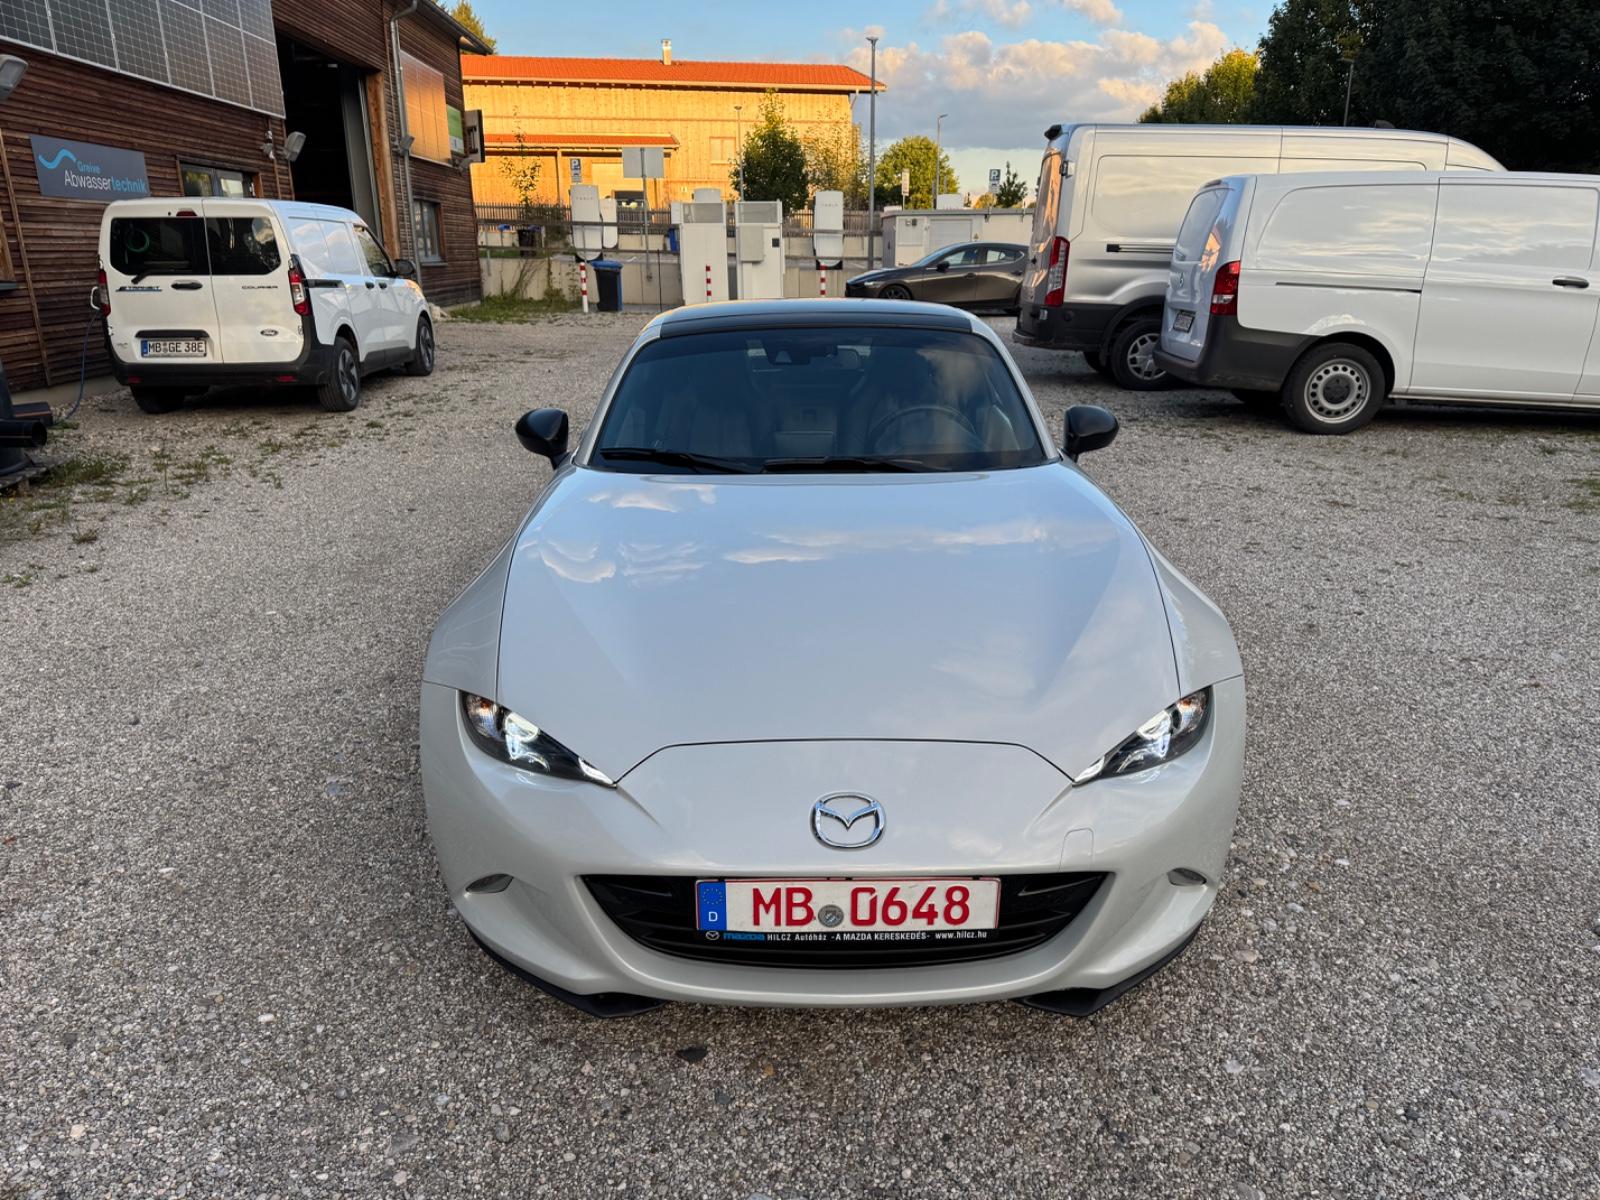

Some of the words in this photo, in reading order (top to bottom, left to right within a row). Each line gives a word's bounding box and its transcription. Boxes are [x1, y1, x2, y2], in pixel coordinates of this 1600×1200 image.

[77, 161, 101, 174] Greive
[64, 169, 147, 192] Abwassertechnik
[148, 342, 162, 353] MB
[168, 342, 182, 353] GE
[184, 342, 204, 353] 38E
[752, 887, 814, 926] MB
[850, 885, 970, 926] 0648
[708, 911, 718, 922] D
[767, 933, 791, 941] HILCZ
[842, 932, 872, 941] MAZDA
[935, 930, 988, 940] www.hilcz.hu
